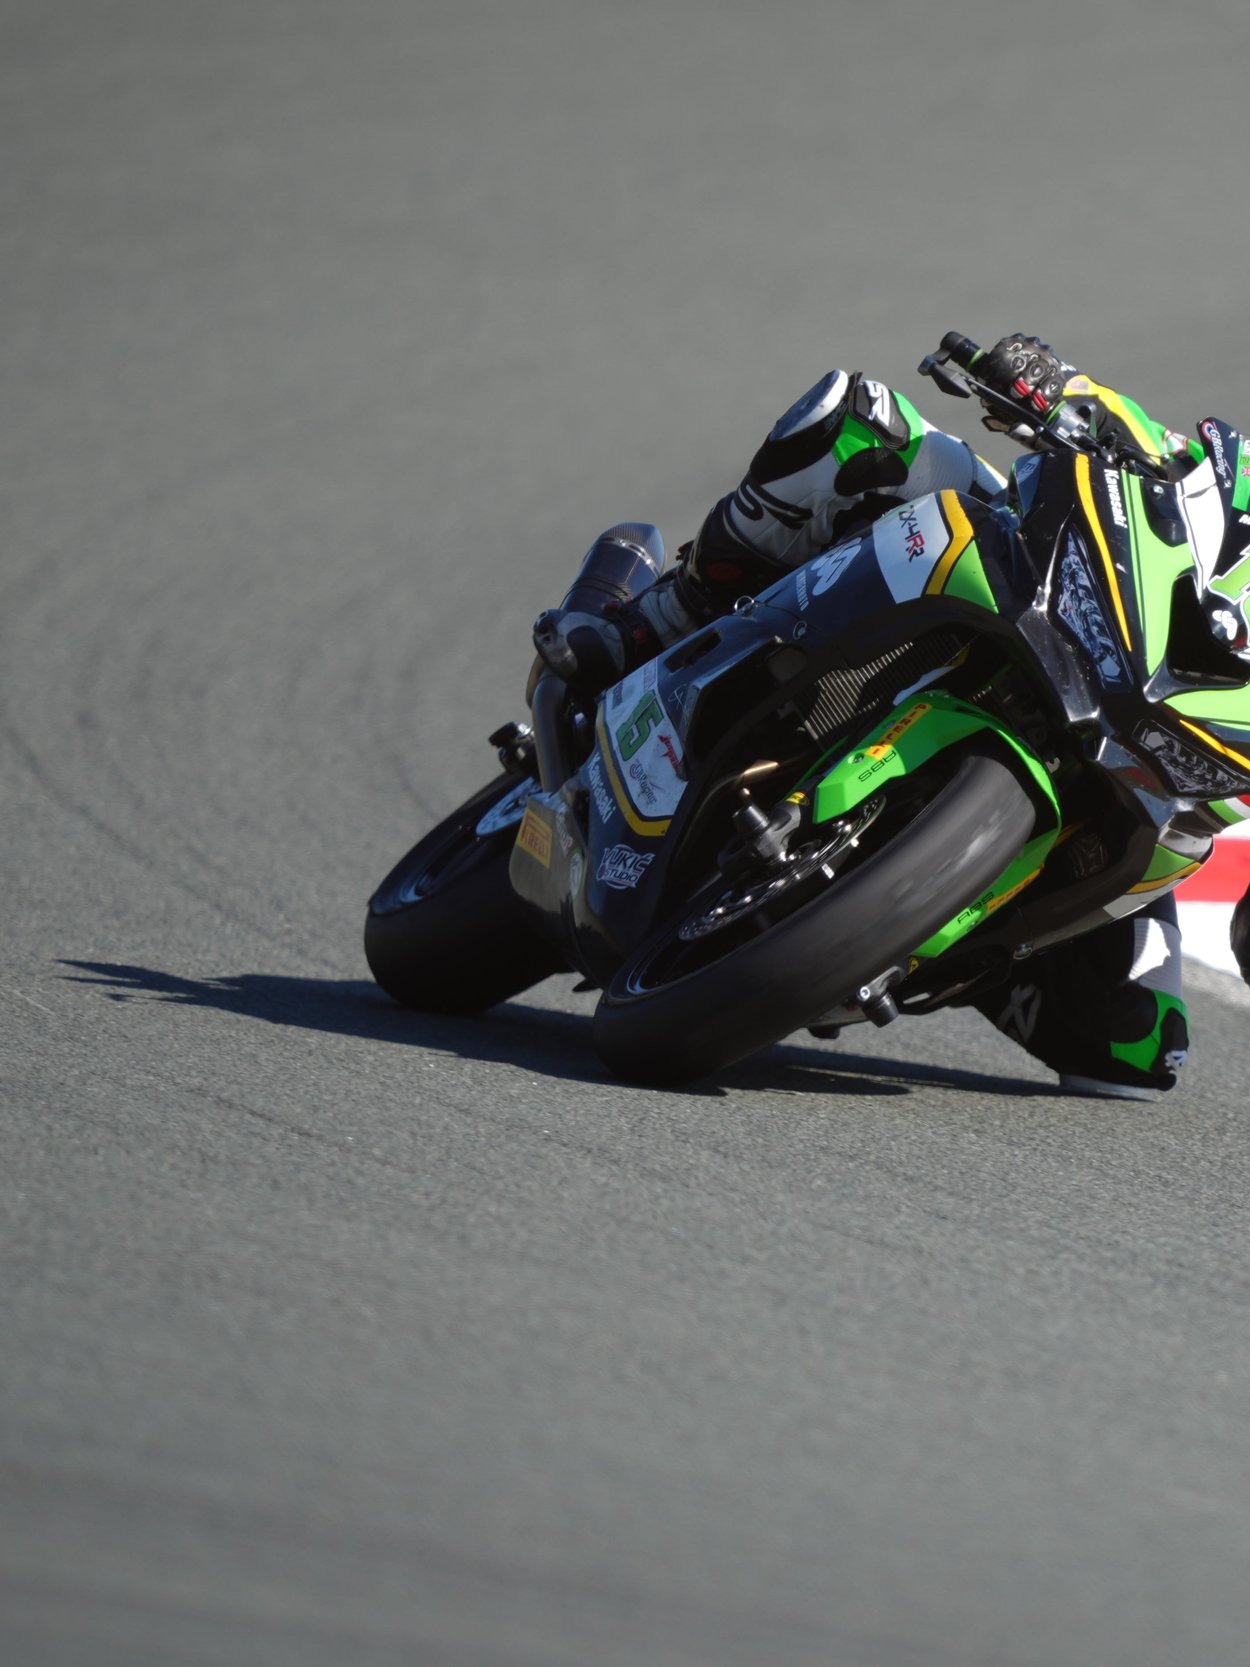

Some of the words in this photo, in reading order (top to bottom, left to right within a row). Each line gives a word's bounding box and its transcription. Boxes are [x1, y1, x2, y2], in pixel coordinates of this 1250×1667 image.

[1103, 469, 1126, 528] Kawasaki
[858, 750, 896, 783] ABS
[588, 752, 617, 825] Kawasaki
[605, 868, 639, 884] STUDIO
[957, 891, 994, 924] ABS
